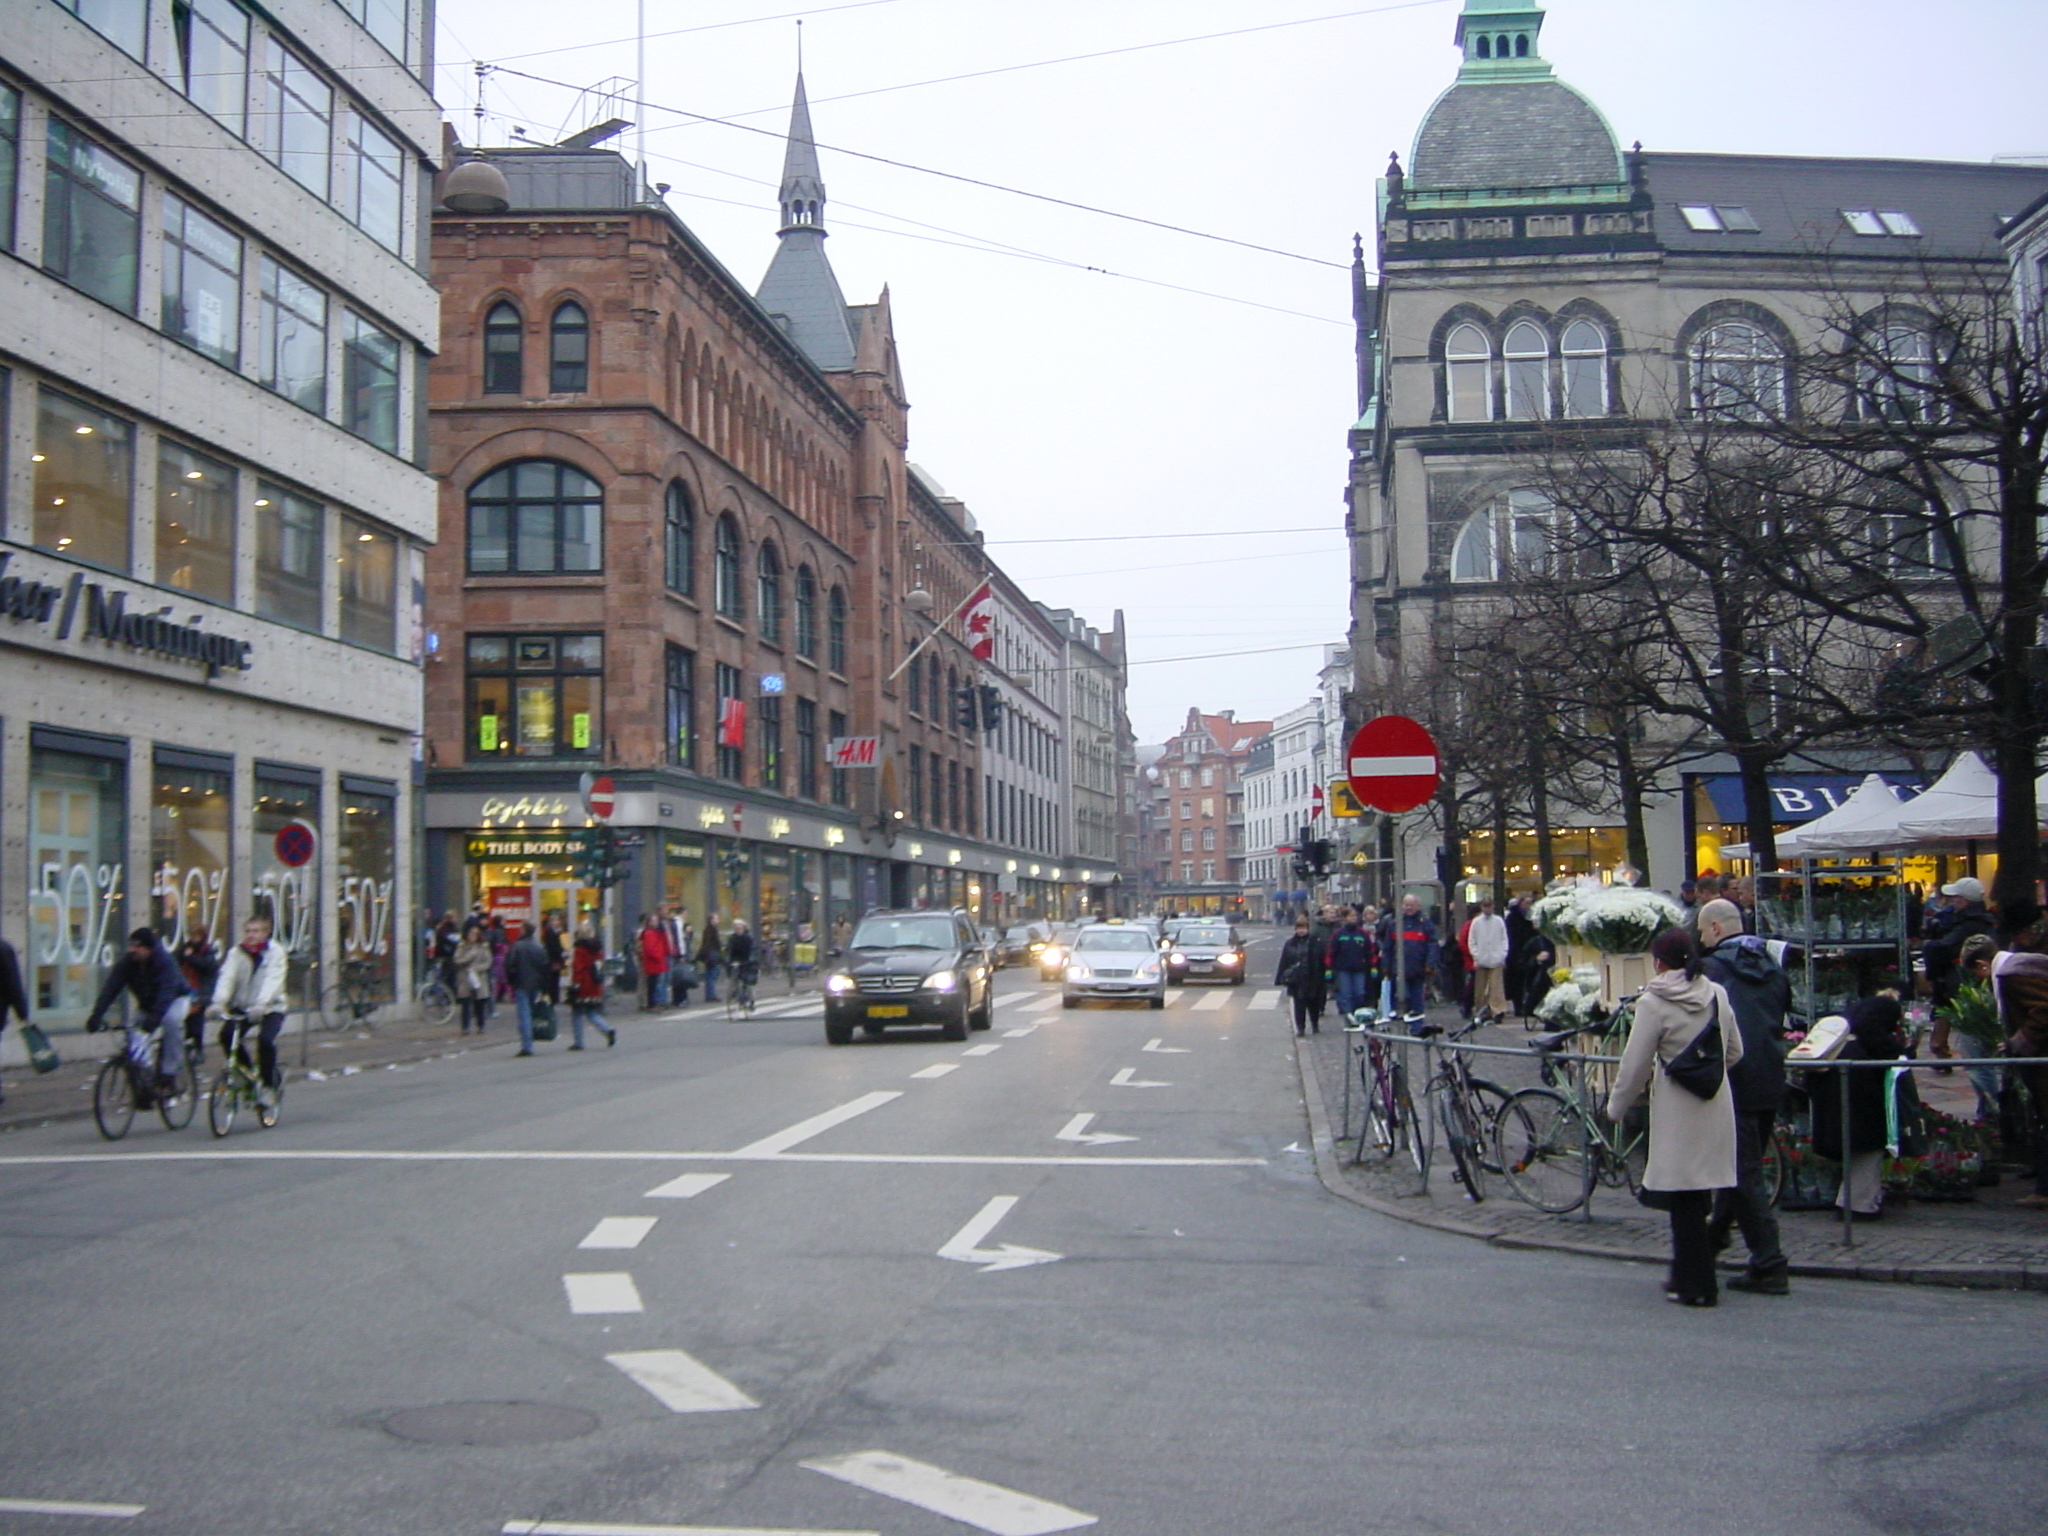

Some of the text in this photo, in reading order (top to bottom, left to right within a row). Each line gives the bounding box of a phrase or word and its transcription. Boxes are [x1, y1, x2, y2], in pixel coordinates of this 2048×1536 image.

[837, 739, 877, 765] H&M
[487, 841, 521, 855] THE
[523, 841, 565, 854] BODY
